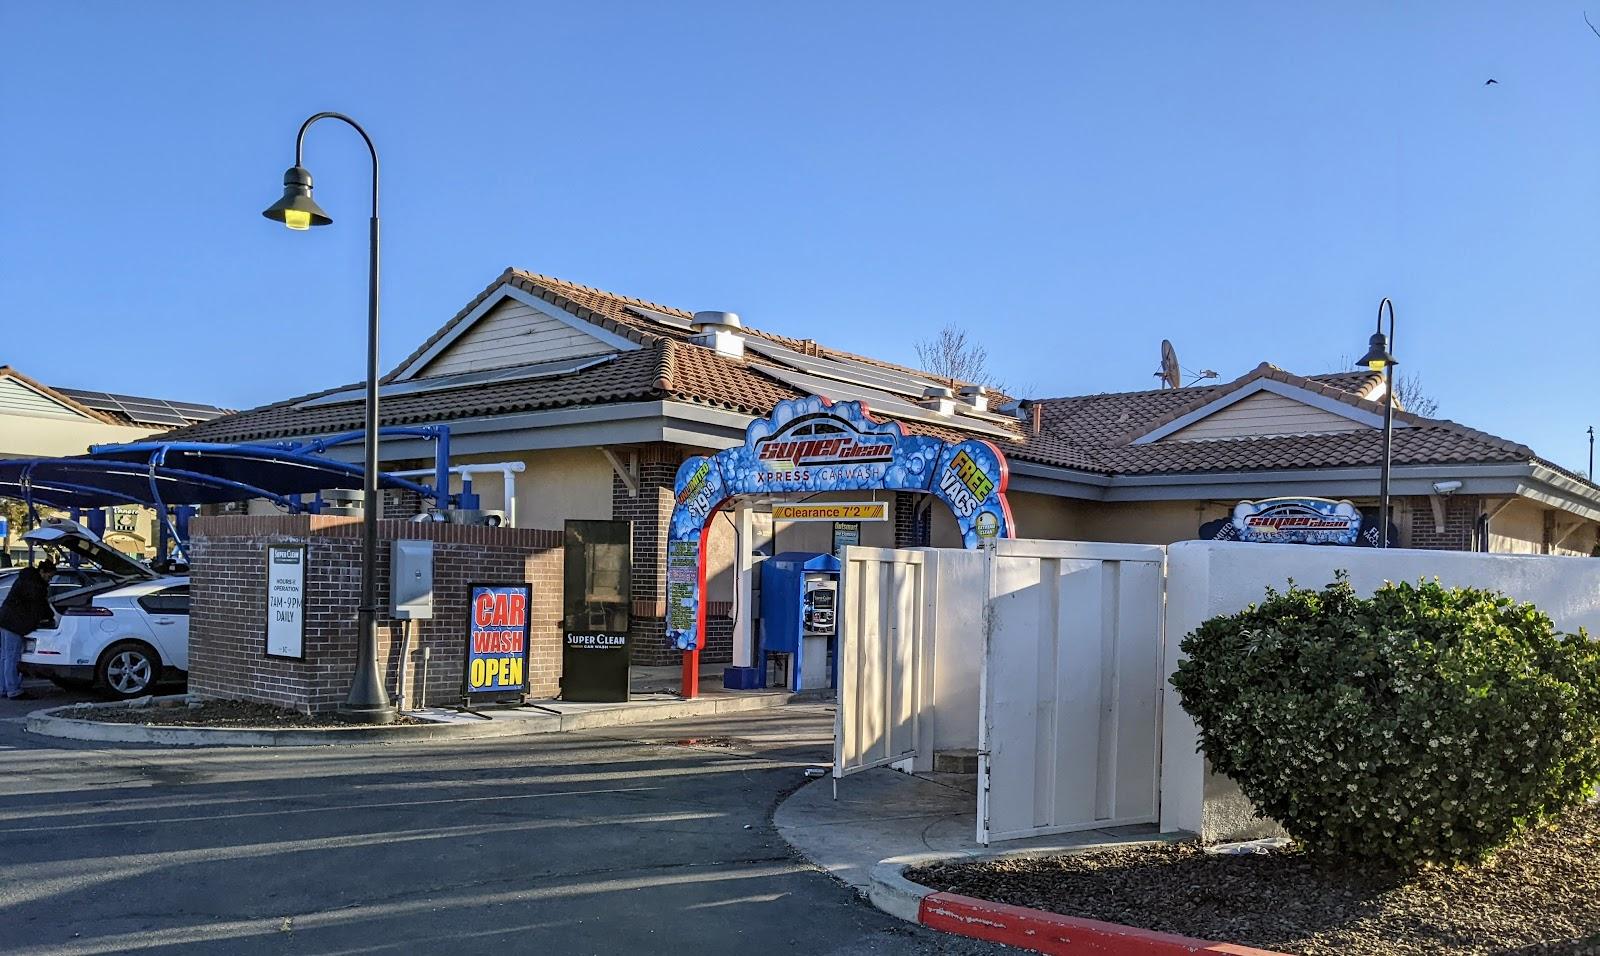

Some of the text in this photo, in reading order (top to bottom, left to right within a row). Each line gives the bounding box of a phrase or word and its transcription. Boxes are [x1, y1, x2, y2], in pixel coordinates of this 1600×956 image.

[677, 461, 709, 505] UNLIMITED
[757, 470, 810, 482] XPRESS
[950, 449, 994, 503] FREE
[940, 469, 977, 517] VACS
[784, 506, 839, 518] Clearance
[276, 610, 294, 622] DAILY
[475, 593, 525, 627] CAR
[473, 631, 523, 653] WASH
[567, 633, 625, 645] SUPER CLEAN
[470, 657, 523, 687] OPEN
